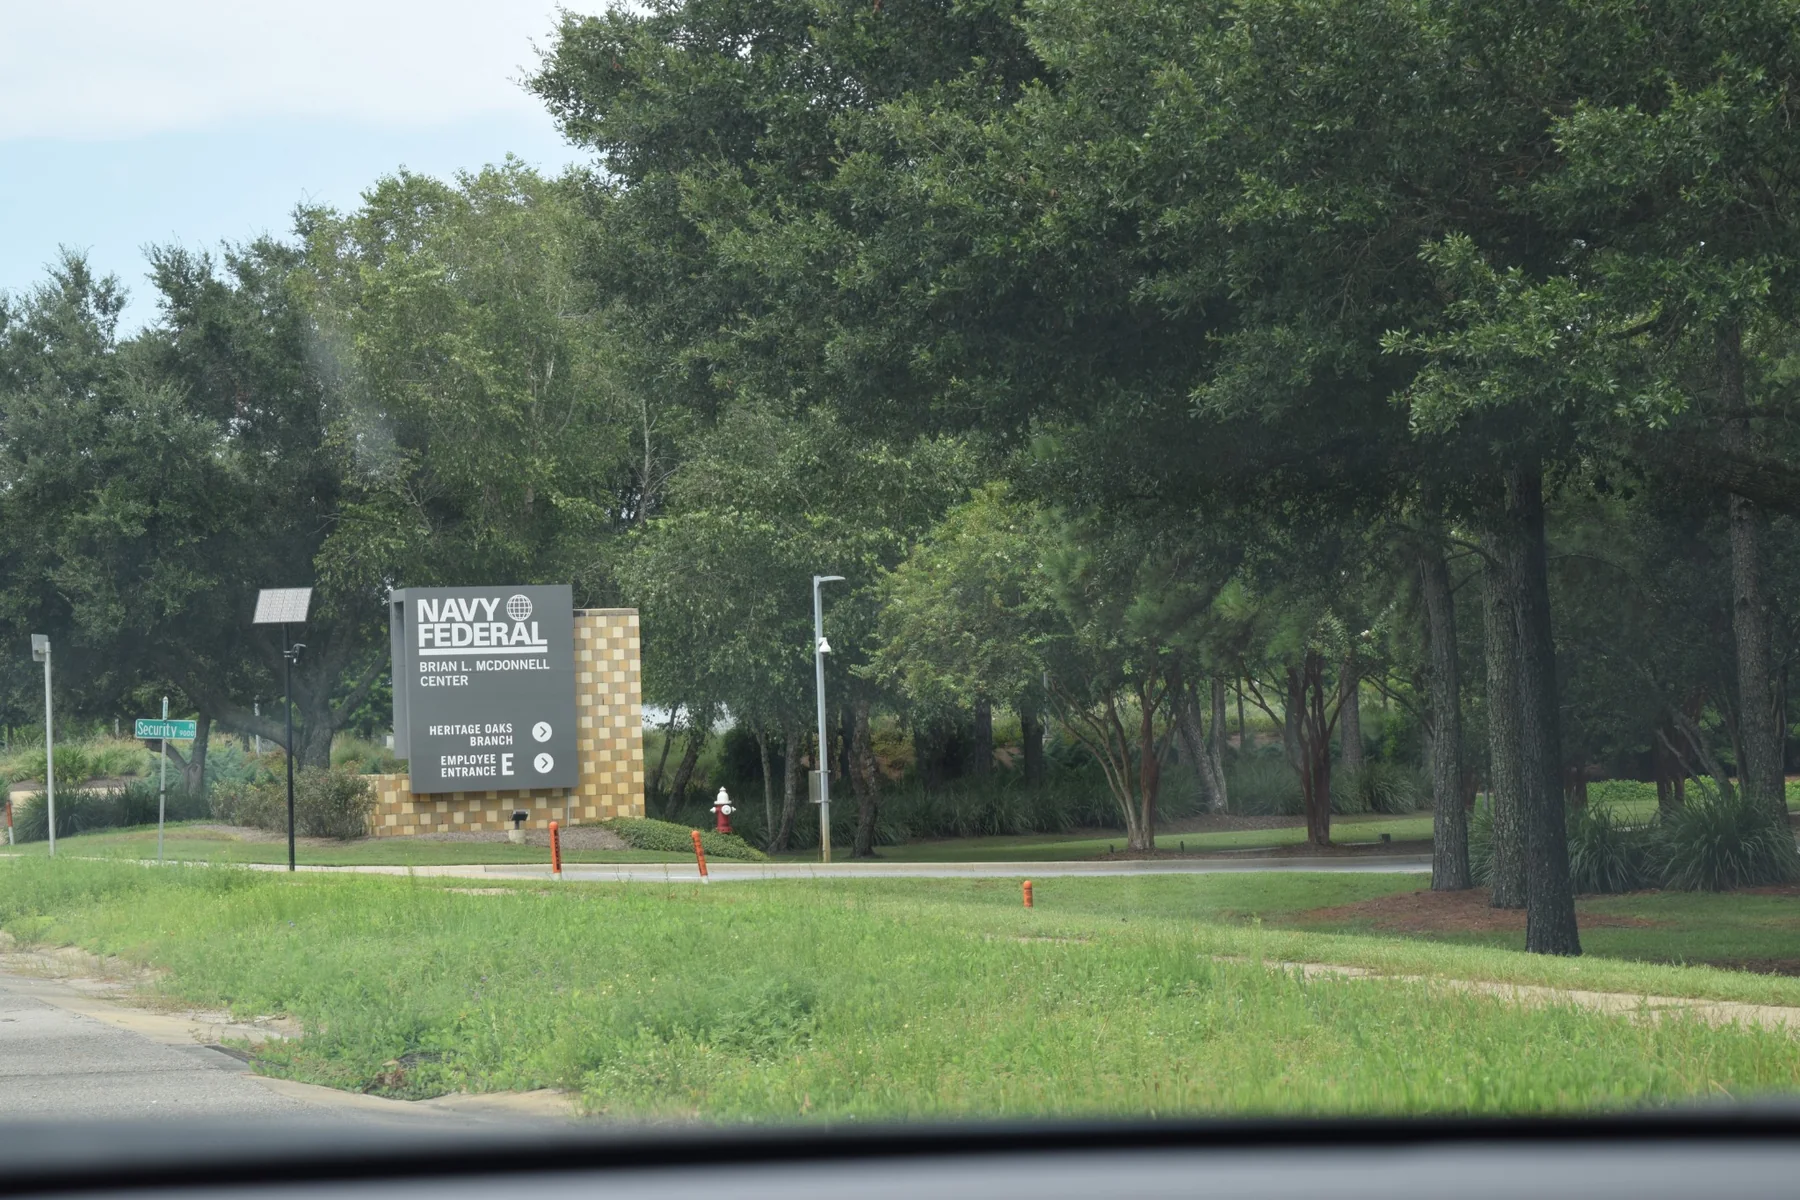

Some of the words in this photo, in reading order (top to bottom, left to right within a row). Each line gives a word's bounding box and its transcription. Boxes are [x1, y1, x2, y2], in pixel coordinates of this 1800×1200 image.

[418, 598, 501, 622] NAVY
[418, 621, 548, 647] FEDERAL
[420, 661, 457, 673] BRIAN
[461, 661, 472, 672] L.
[476, 659, 550, 671] MCDONNELL
[420, 675, 468, 686] CENTER
[138, 722, 177, 737] Security
[429, 724, 481, 735] HERITAGE
[485, 723, 513, 734] OAKS
[470, 735, 513, 746] BRANCH
[440, 754, 496, 765] EMPLOYEE
[501, 753, 514, 776] E
[441, 766, 496, 777] ENTRANCE
